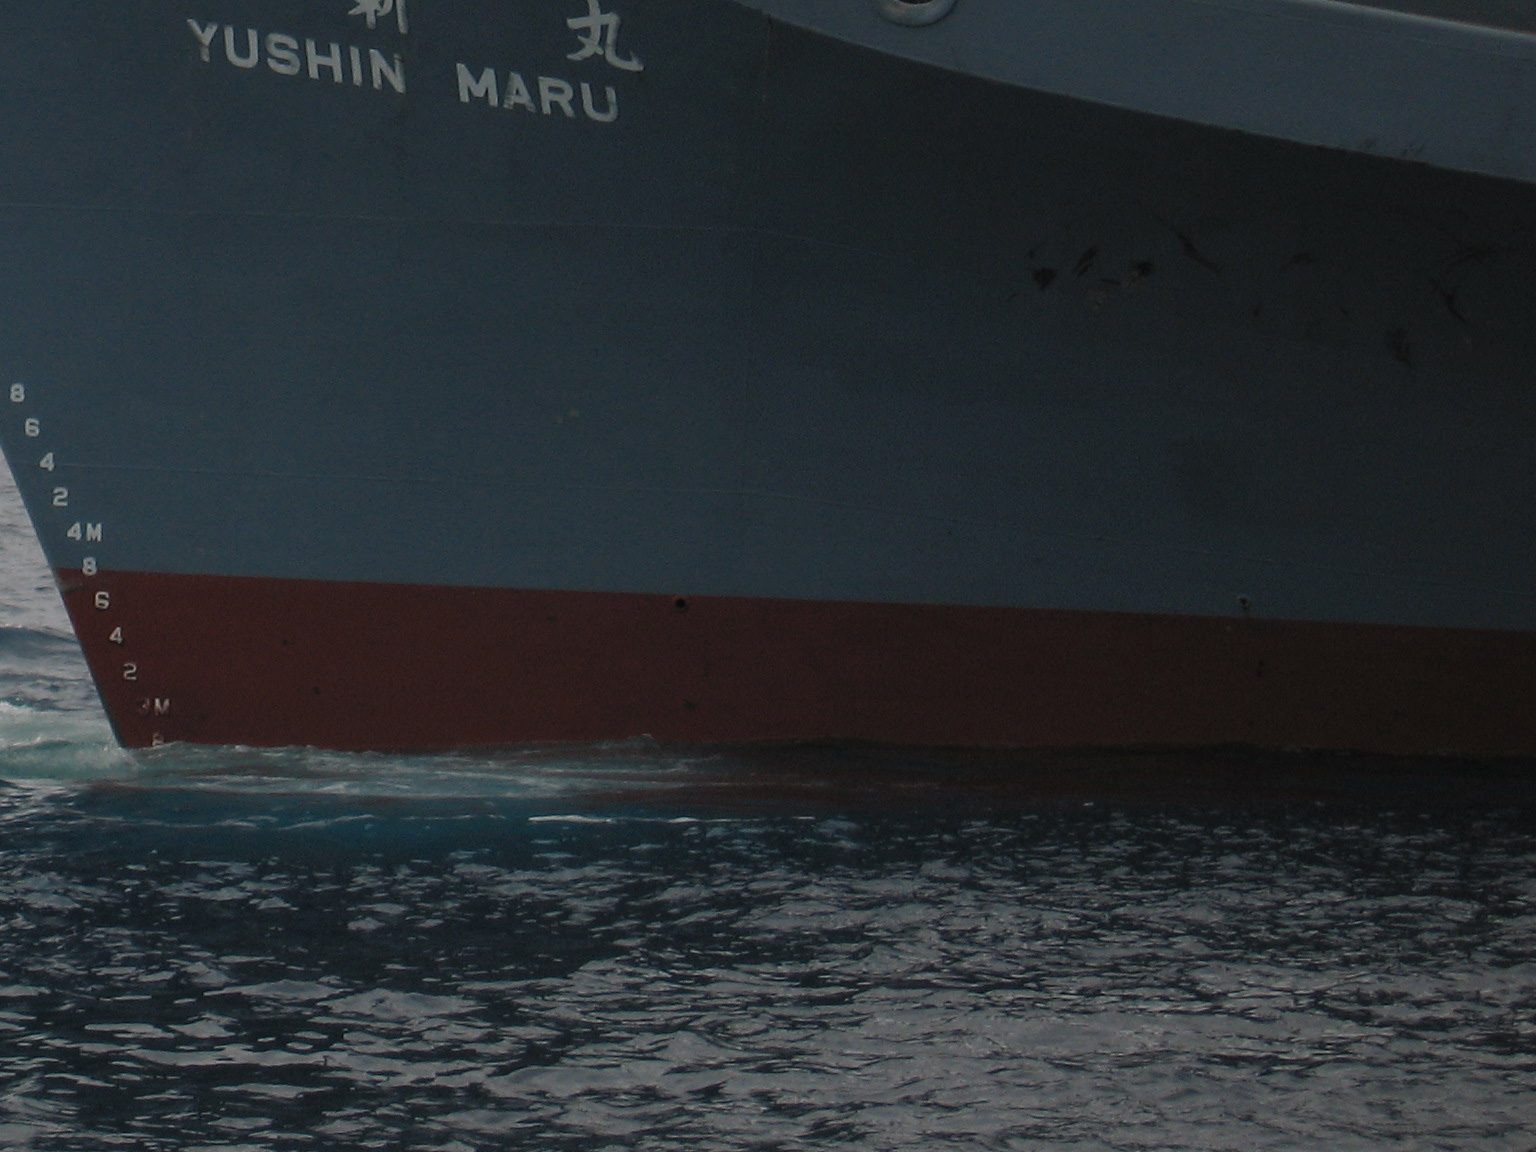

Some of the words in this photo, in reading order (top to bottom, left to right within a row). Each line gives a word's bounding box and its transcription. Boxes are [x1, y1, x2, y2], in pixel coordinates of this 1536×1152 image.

[187, 18, 405, 94] YUSHIN
[456, 63, 619, 123] MARU
[10, 383, 25, 403] 8
[24, 418, 40, 437] 6
[39, 452, 55, 472] 4
[52, 487, 68, 507] 2
[67, 522, 102, 542] 4M
[82, 557, 97, 576] 8
[95, 591, 109, 610] 6
[109, 626, 123, 644] 4
[123, 663, 137, 681] 2
